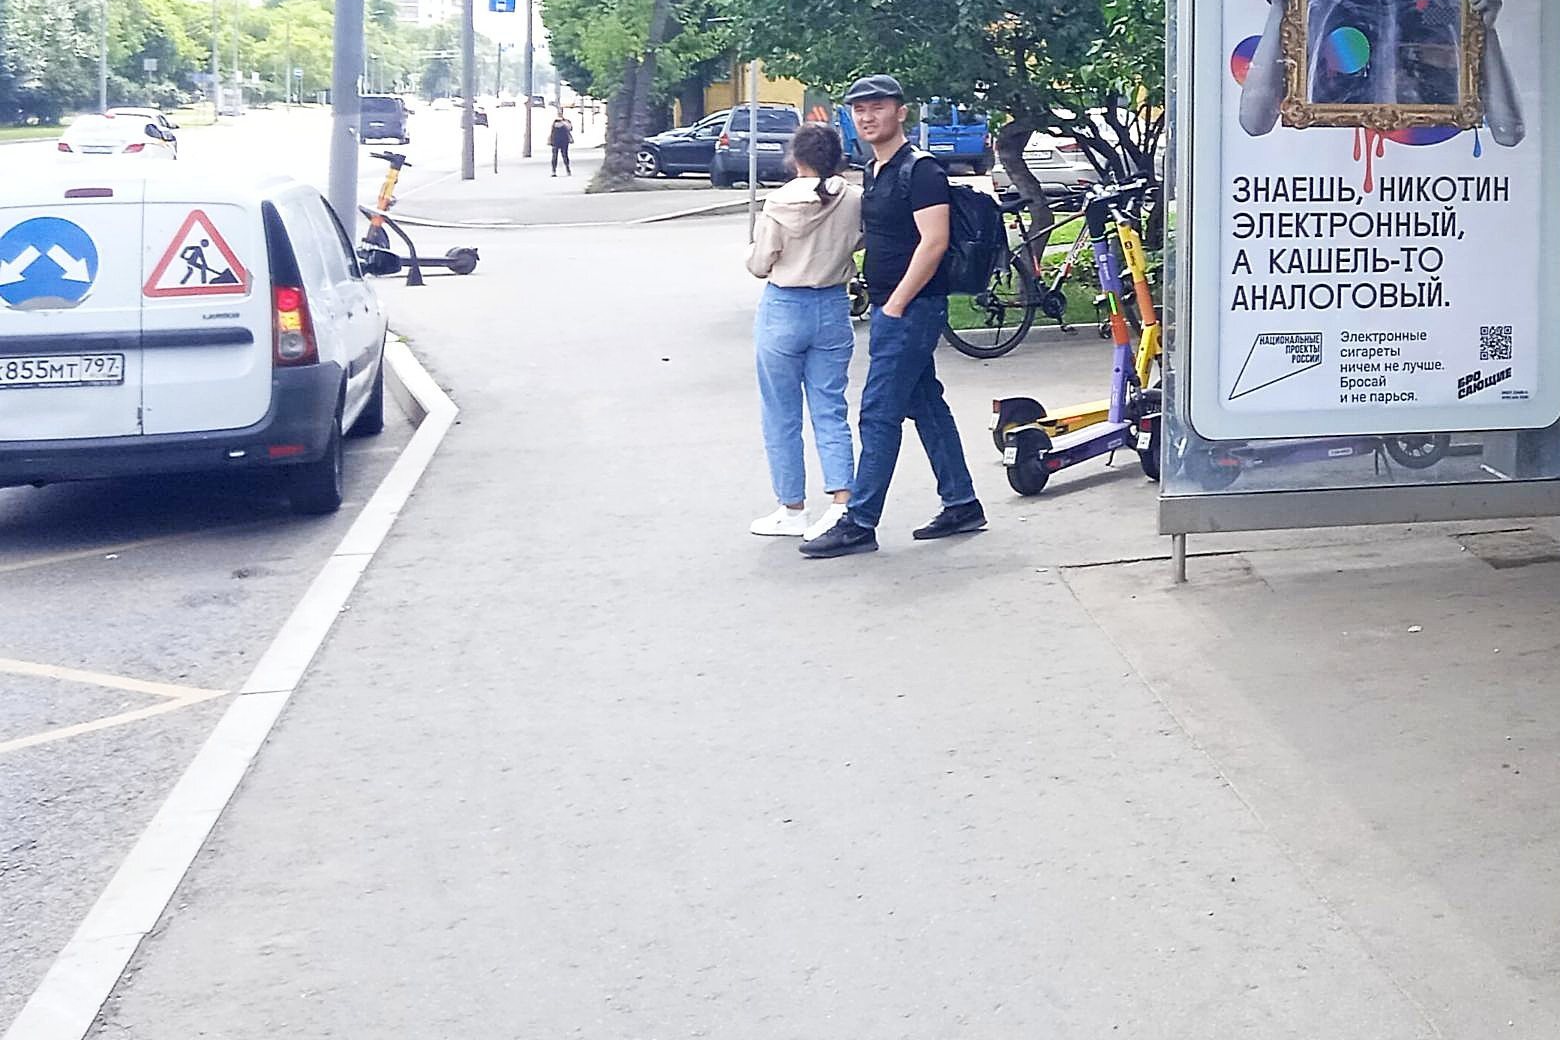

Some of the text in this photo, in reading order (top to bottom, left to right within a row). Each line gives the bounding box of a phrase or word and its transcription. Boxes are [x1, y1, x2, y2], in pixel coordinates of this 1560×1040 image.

[1232, 176, 1510, 205] ЗНАЕШЬ, НИКОТИН
[1231, 206, 1465, 240] ЭЛЕКТРОННЫЙ,
[1231, 246, 1443, 275] А КАШЕЛЬ-ТО
[1231, 277, 1451, 311] АНАЛОГОВЫЙ.
[1259, 334, 1320, 345] НАЦИОНАЛЬНЫЕ
[1340, 331, 1427, 342] Электронные
[1285, 345, 1320, 354] ПРОЕКТЫ
[1340, 346, 1400, 359] сигареты
[1291, 354, 1320, 364] РОССИИ
[0, 357, 117, 380] 855МТ 797
[1340, 360, 1445, 375] ничем не лучше.
[1340, 375, 1387, 390] Бросай
[1457, 370, 1481, 389] БРО
[1458, 367, 1512, 400] САЮЩИЕ
[1340, 391, 1419, 405] и не парься.
